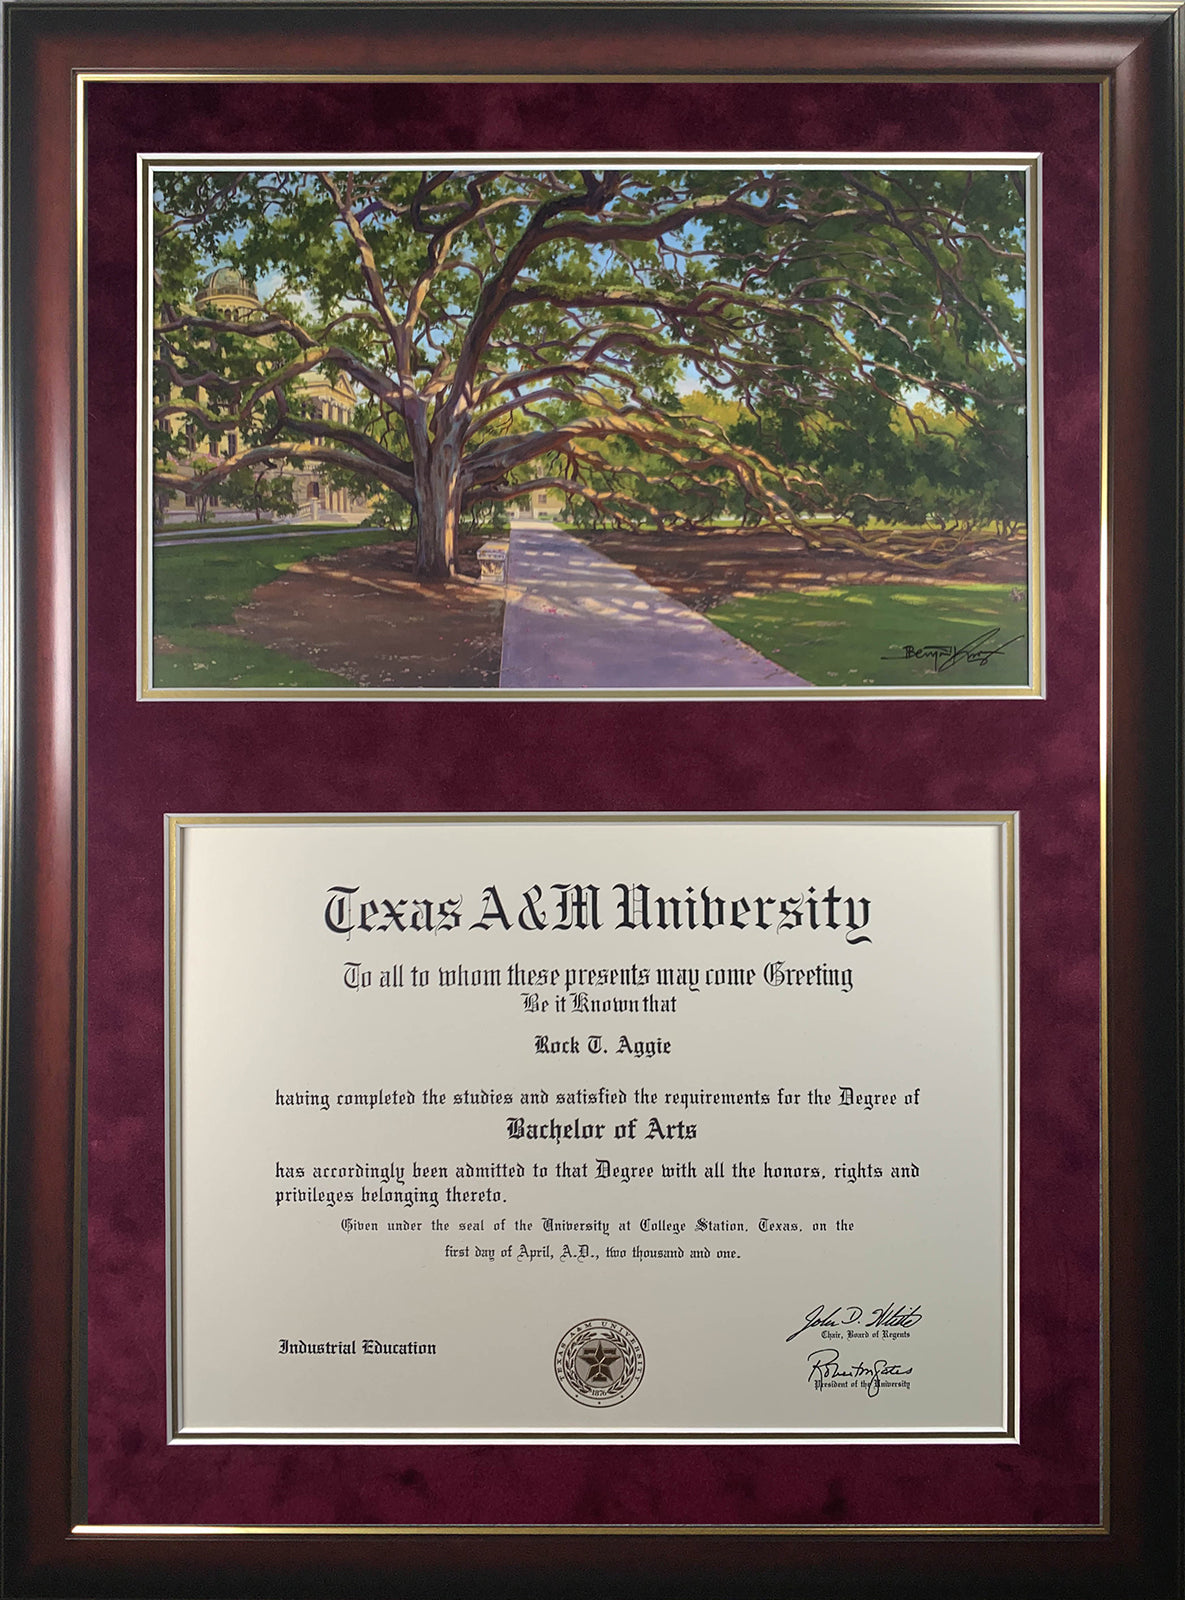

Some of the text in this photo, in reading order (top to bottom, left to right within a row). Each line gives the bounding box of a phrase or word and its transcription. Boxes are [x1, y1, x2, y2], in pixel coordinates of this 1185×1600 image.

[324, 882, 873, 946] Texas A&M University
[343, 960, 854, 994] To all to whom these presents may come Greeting
[520, 992, 677, 1014] Be it Known that
[534, 1034, 672, 1059] Rock T. Aggie
[274, 1085, 921, 1111] having completed the studies and satisfied the requirements for the Degree of
[505, 1116, 698, 1145] Bachelor of Arts
[275, 1157, 920, 1185] has accordingly been admitted to that Degree with all the honors, rights and
[275, 1185, 507, 1208] privileges belonging thereto.
[340, 1217, 855, 1237] Given under the seal of the University at College Station, Texas, on the
[444, 1243, 741, 1264] first day of April, A.D., two thousand and one.
[277, 1338, 437, 1356] Industrial Education
[820, 1330, 911, 1341] Chair, Board of Regents
[850, 1380, 859, 1388] of
